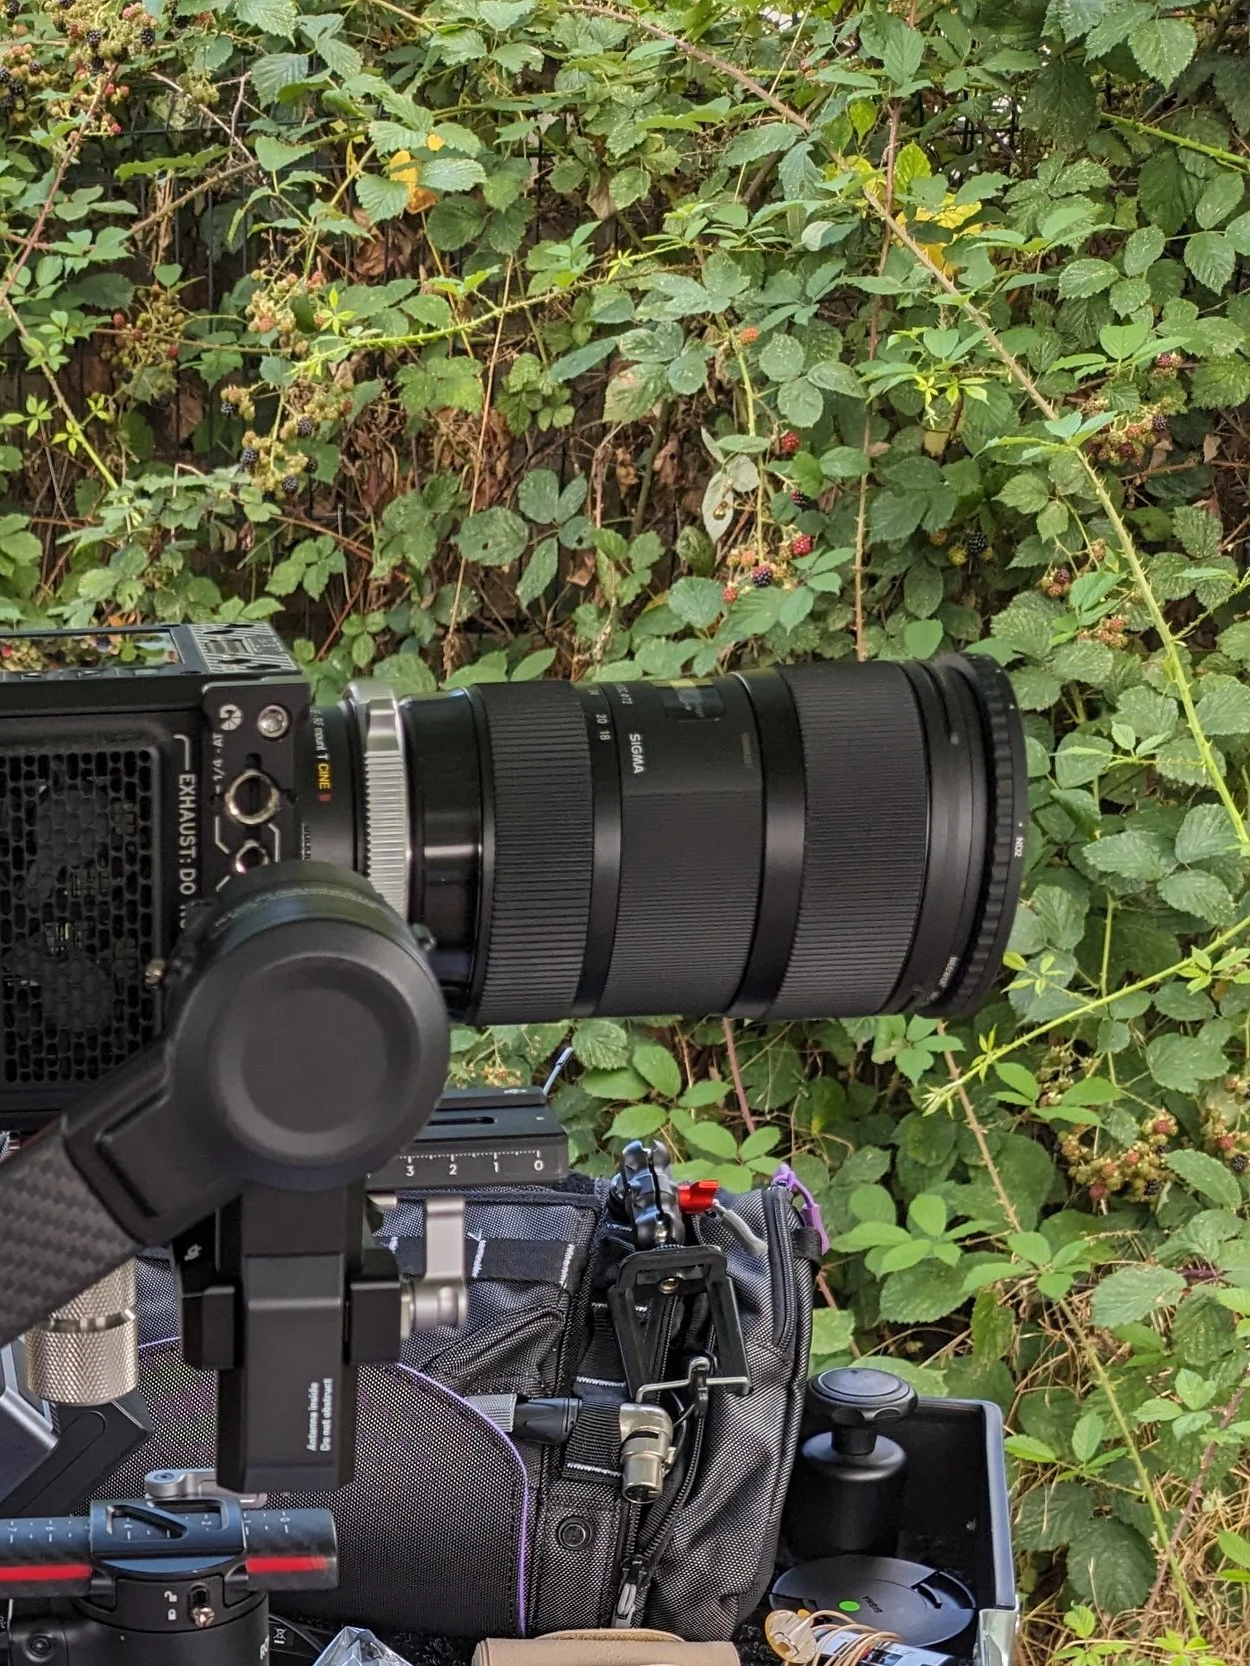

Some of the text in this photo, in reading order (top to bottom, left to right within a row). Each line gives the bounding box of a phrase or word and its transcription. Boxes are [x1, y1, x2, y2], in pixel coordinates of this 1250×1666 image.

[595, 714, 608, 724] 20
[600, 731, 611, 741] 18
[629, 733, 646, 775] SIGMA
[317, 763, 331, 790] CINE
[178, 773, 197, 864] EXHAUST:
[1014, 836, 1024, 858] ND2
[179, 868, 196, 895] DO
[406, 1160, 544, 1177] 3 2 1 0
[306, 1382, 319, 1452] Antenna inside
[320, 1378, 332, 1451] Do not obstruct
